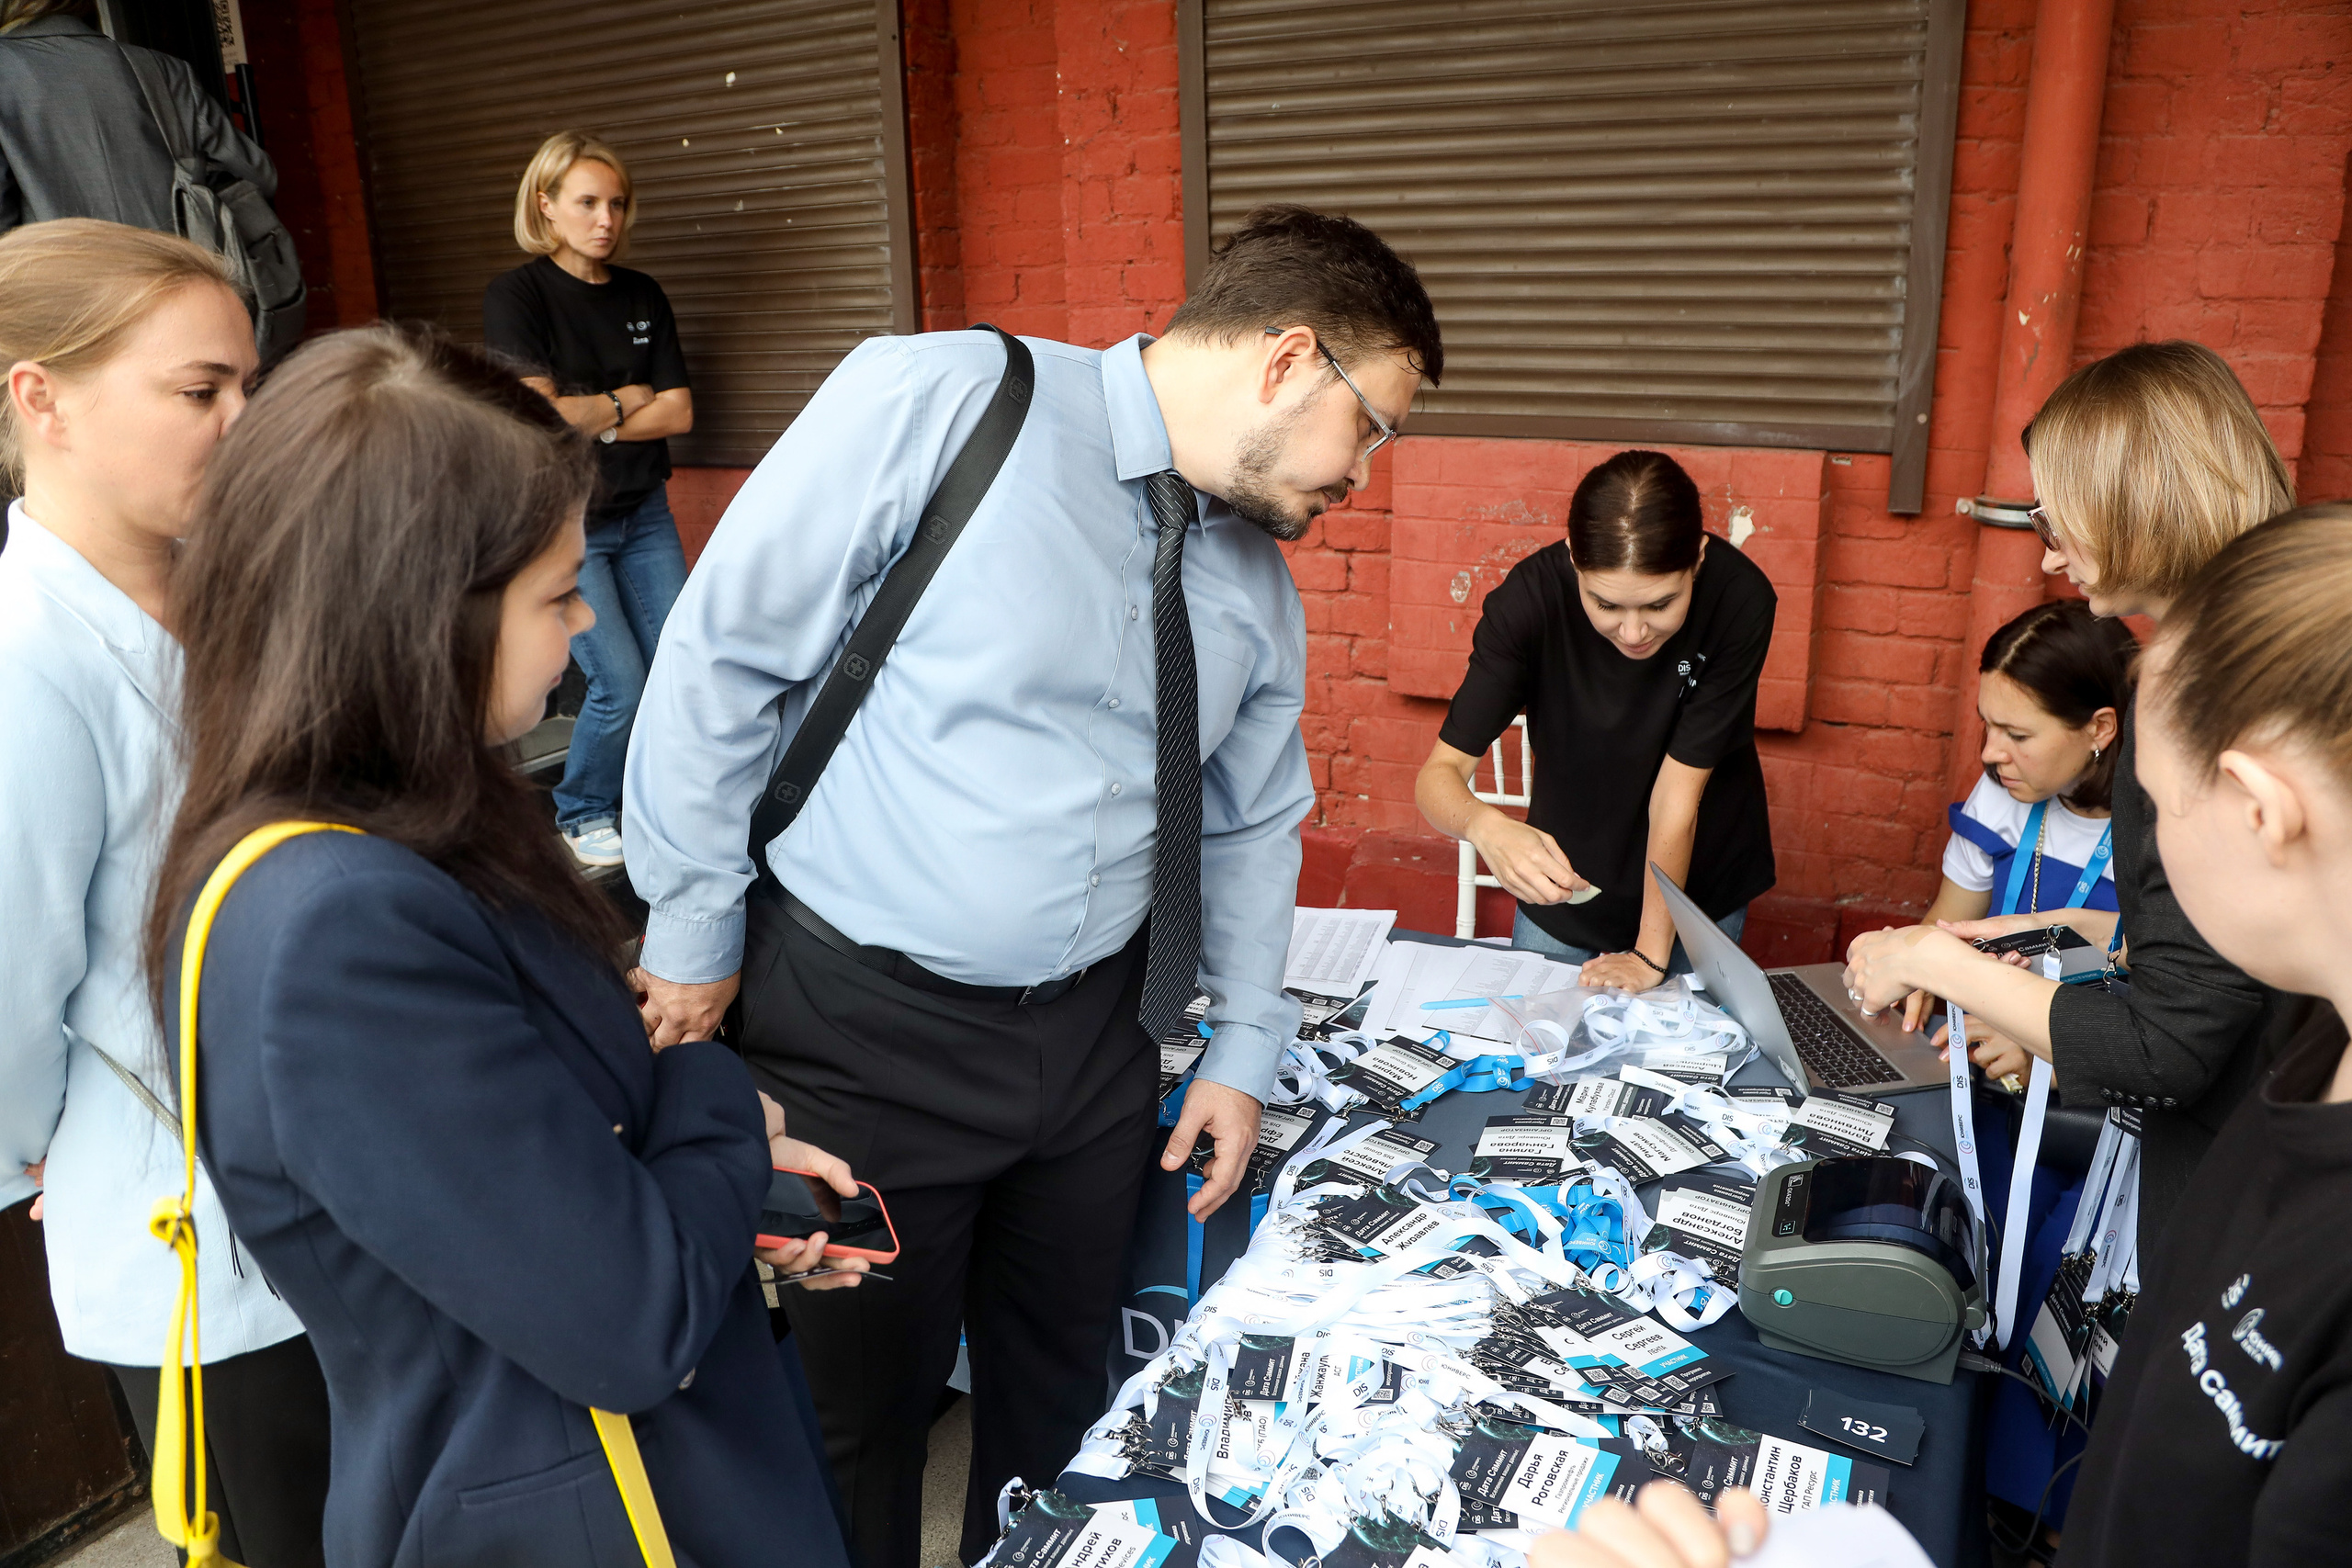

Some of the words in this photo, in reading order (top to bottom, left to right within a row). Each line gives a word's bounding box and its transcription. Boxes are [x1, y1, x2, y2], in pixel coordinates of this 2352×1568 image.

[1678, 664, 1690, 672] DIS
[1373, 1057, 1418, 1080] Новикова
[1546, 1056, 1559, 1065] DIS
[1373, 1064, 1403, 1080] Мария
[1363, 1075, 1387, 1089] Саммит
[1956, 1075, 1964, 1089] DIS
[1576, 1086, 1590, 1105] Мария
[1261, 1111, 1295, 1122] ОРГАНИЗА
[1722, 1113, 1734, 1122] DIS
[1824, 1102, 1876, 1119] ОРГАНИЗАТОР
[1807, 1119, 1871, 1143] Валентина
[1809, 1113, 1875, 1135] Литвинова
[1633, 1132, 1671, 1161] Магсумов
[1657, 1125, 1695, 1153] ОРГАНИЗАТОР
[1819, 1137, 1850, 1150] Саммит
[1363, 1146, 1381, 1155] Group
[1611, 1147, 1634, 1167] Саммит
[1630, 1140, 1654, 1158] Ринат
[1852, 1146, 1871, 1156] Дата
[1341, 1156, 1387, 1176] Алексей
[1343, 1150, 1394, 1168] льверсто
[1286, 1165, 1296, 1177] DIS
[1633, 1164, 1649, 1178] Дата
[1689, 1203, 1709, 1213] Дата
[1694, 1195, 1752, 1215] ОРГАНИЗАТОР
[1355, 1224, 1372, 1237] Дата
[1368, 1210, 1391, 1228] Саммит
[1681, 1212, 1743, 1235] Богданов
[1710, 1209, 1747, 1225] Юниверс
[1381, 1213, 1428, 1246] Александр
[1395, 1220, 1440, 1251] Журавлев
[1672, 1217, 1744, 1245] Александр
[1684, 1239, 1718, 1255] Саммит
[1718, 1252, 1741, 1263] Дата
[2101, 1245, 2110, 1269] ЮНИВЕРС
[1319, 1269, 1333, 1277] DIS
[1480, 1263, 1495, 1274] DIS
[1575, 1320, 1590, 1331] Дата
[1589, 1312, 1613, 1326] Саммит
[2050, 1293, 2061, 1309] Дата
[2059, 1308, 2072, 1332] Саммит
[1611, 1325, 1646, 1341] Сергей
[1624, 1334, 1664, 1352] Сергеев
[1648, 1345, 1668, 1356] ЛЕНТА
[2181, 1321, 2208, 1377] Дата
[1263, 1358, 1276, 1382] Саммит
[1441, 1363, 1471, 1379] ЮНИВЕРС
[1659, 1353, 1689, 1370] УЧАСТНИК
[1211, 1378, 1220, 1392] DIS
[1260, 1380, 1271, 1396] Дата
[1353, 1382, 1369, 1397] DIS
[1305, 1409, 1326, 1433] ЮНИВЕРС
[2199, 1369, 2287, 1461] Саммит
[1258, 1416, 1268, 1438] (ПАО)
[1839, 1416, 1889, 1444] 132
[1200, 1429, 1211, 1450] ЮНИВЕРС
[1477, 1476, 1493, 1497] Дата
[1487, 1449, 1508, 1479] Саммит
[1517, 1453, 1544, 1489] Дарья
[1532, 1450, 1569, 1506] Роговская
[1575, 1457, 1589, 1480] продажи
[1729, 1455, 1739, 1487] Саммит
[1582, 1472, 1606, 1510] УЧАСТНИК
[1777, 1455, 1803, 1514] Щербаков
[1806, 1470, 1817, 1497] Ресурс
[1301, 1486, 1316, 1502] DIS
[1801, 1495, 1812, 1511] ГАП
[1435, 1519, 1448, 1538] DIS
[1035, 1529, 1061, 1558] Саммит
